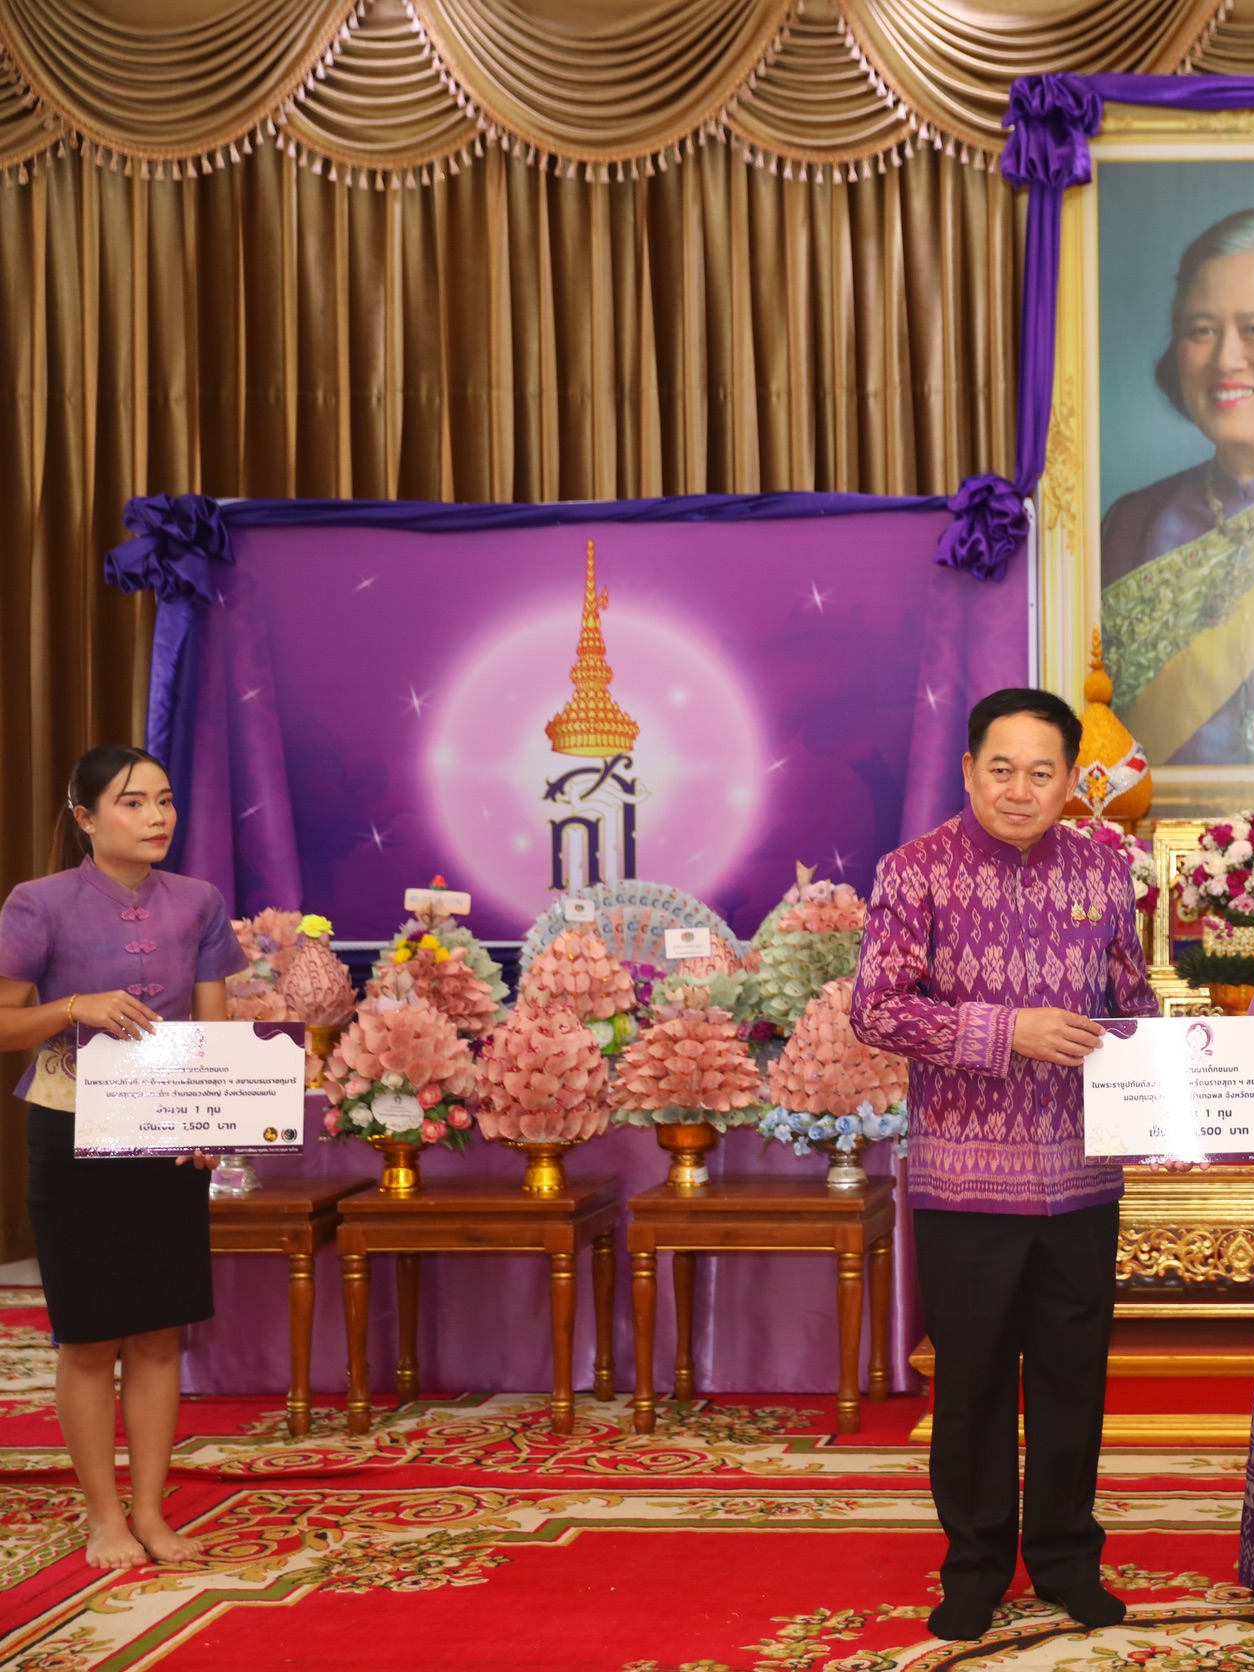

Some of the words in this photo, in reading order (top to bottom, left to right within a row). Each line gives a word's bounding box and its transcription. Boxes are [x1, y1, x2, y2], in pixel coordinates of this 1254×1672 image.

[195, 1105, 200, 1114] 1
[206, 1105, 221, 1117] ทุน
[1205, 1108, 1210, 1118] 1
[1217, 1108, 1233, 1120] ทุน
[1229, 1125, 1249, 1136] บาท
